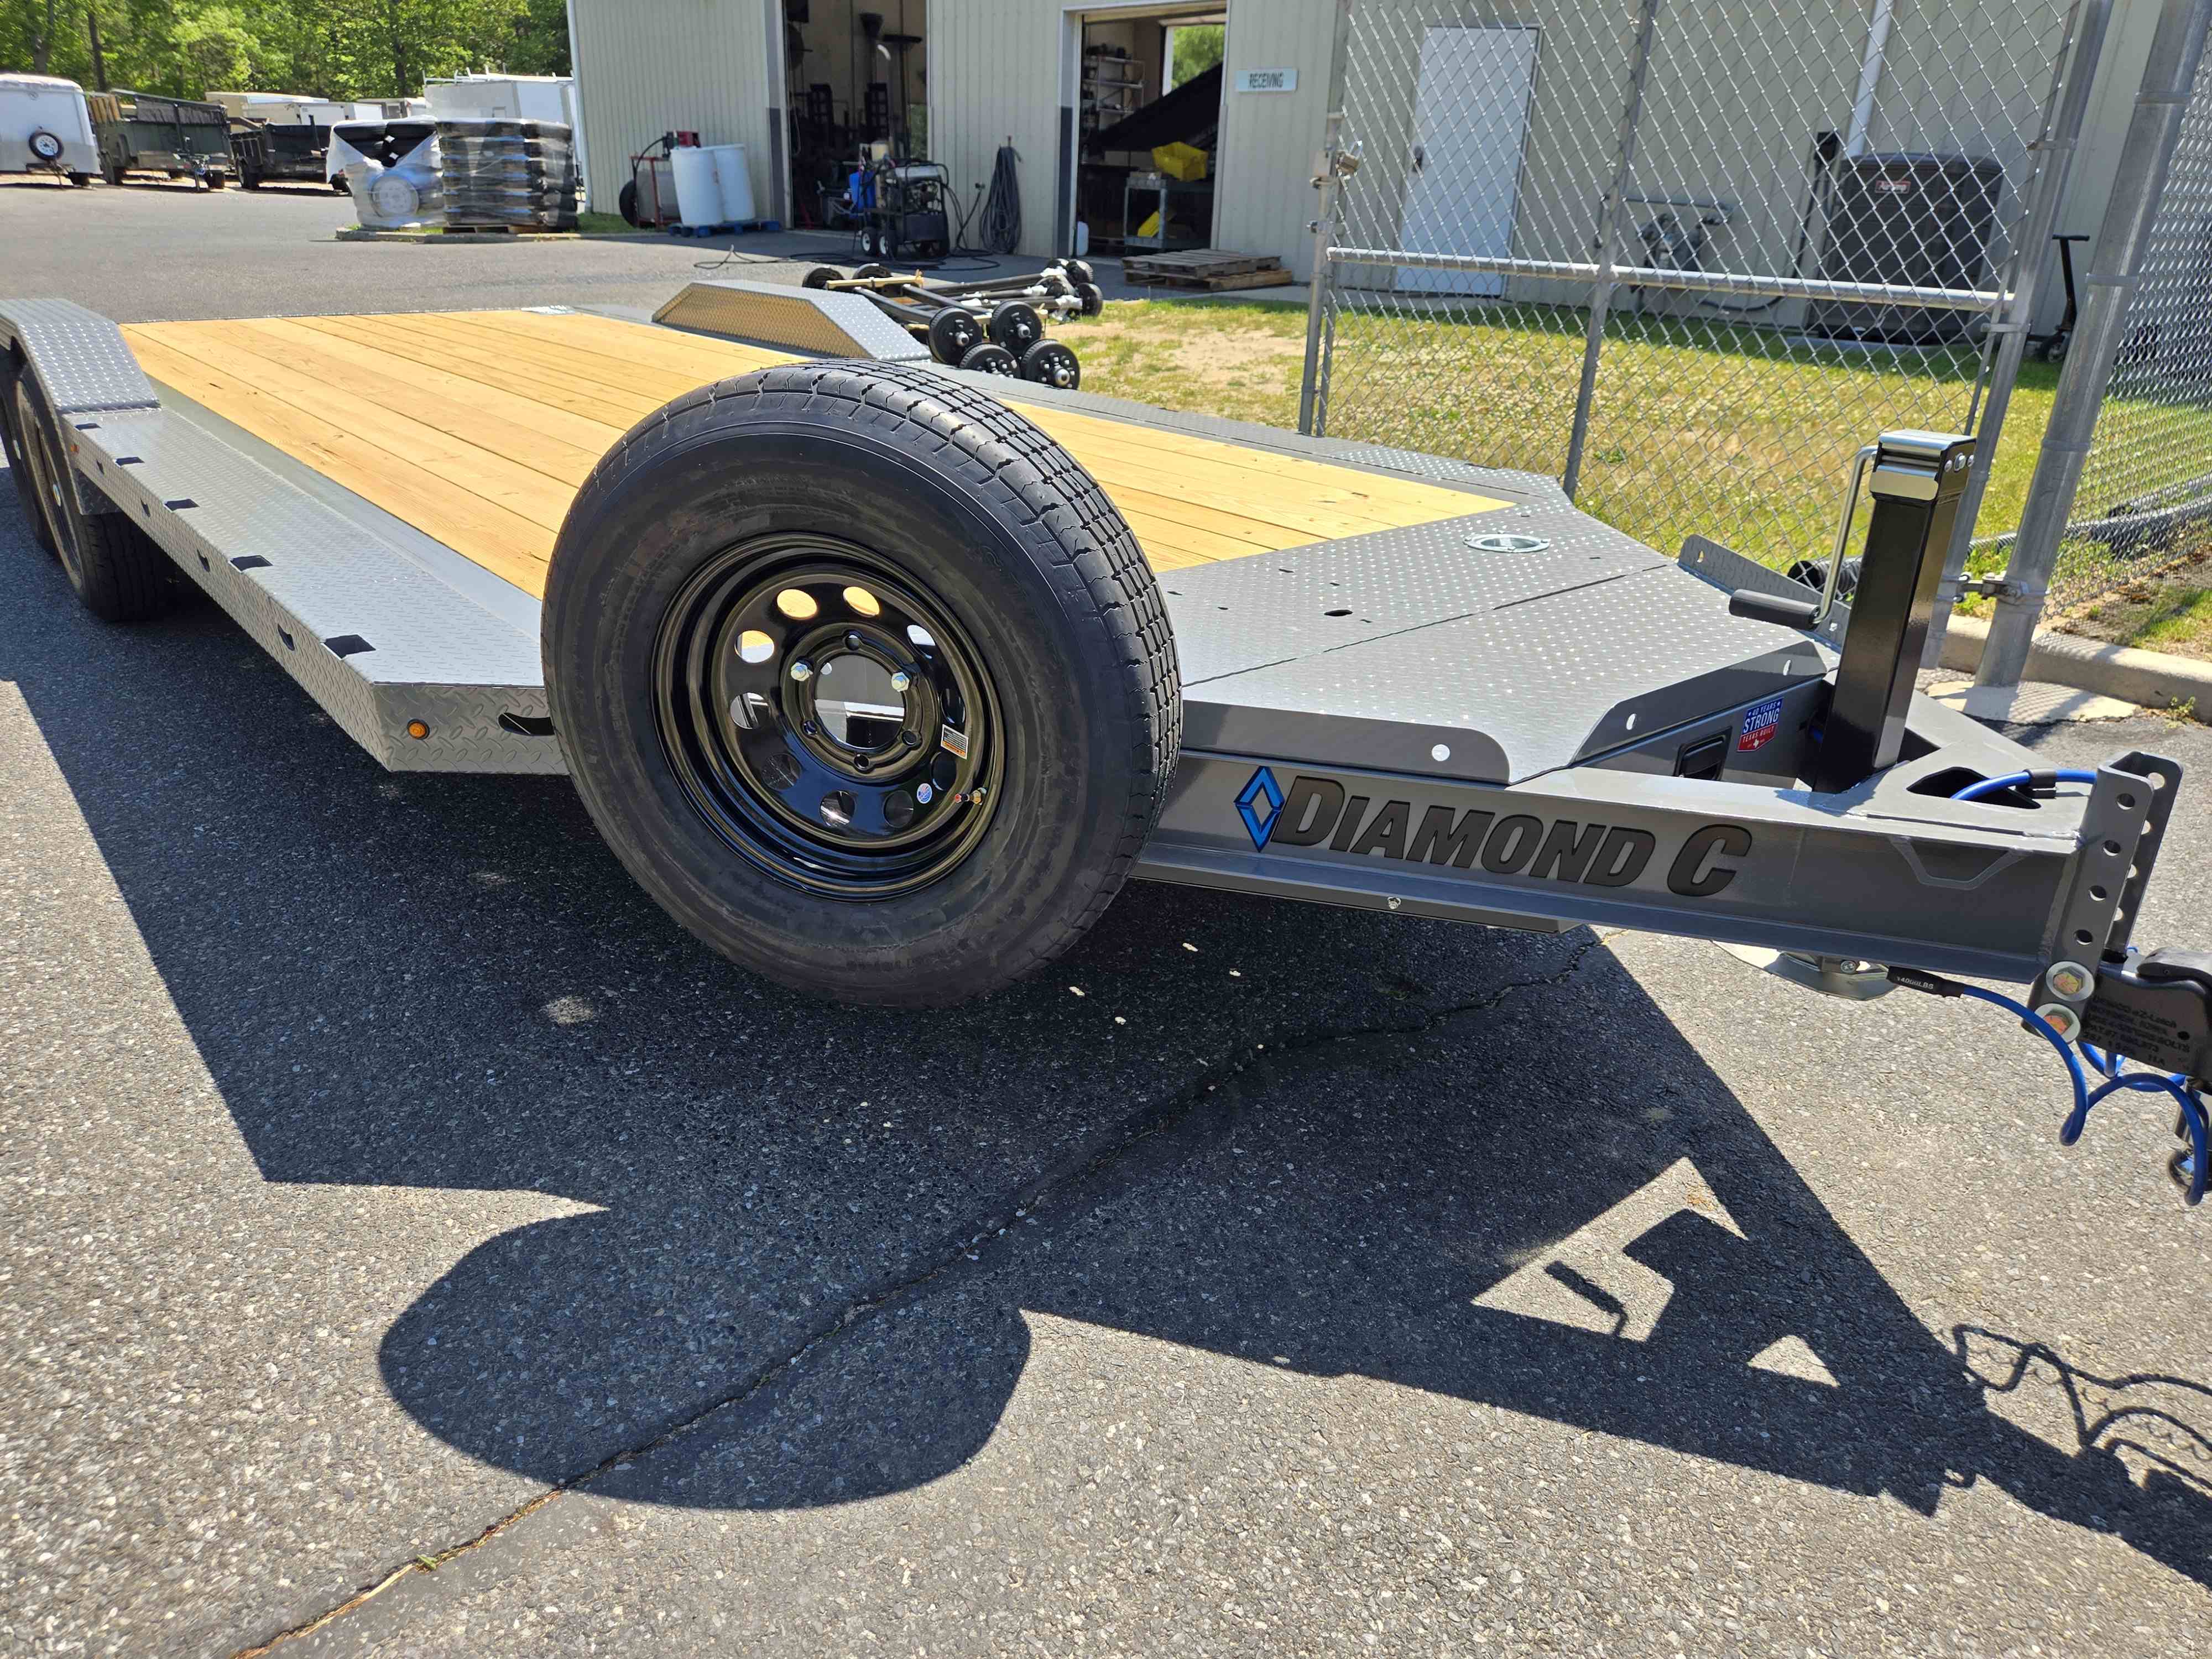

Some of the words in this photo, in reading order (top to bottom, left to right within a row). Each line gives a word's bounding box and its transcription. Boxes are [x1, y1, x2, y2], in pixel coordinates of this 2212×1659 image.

[1248, 72, 1284, 88] RECEIVING
[1760, 702, 1776, 712] YEARS
[1743, 708, 1779, 733] STRONG
[1743, 732, 1759, 743] TEXAS
[1270, 776, 1656, 886] DIAMOND
[1667, 823, 1753, 897] C
